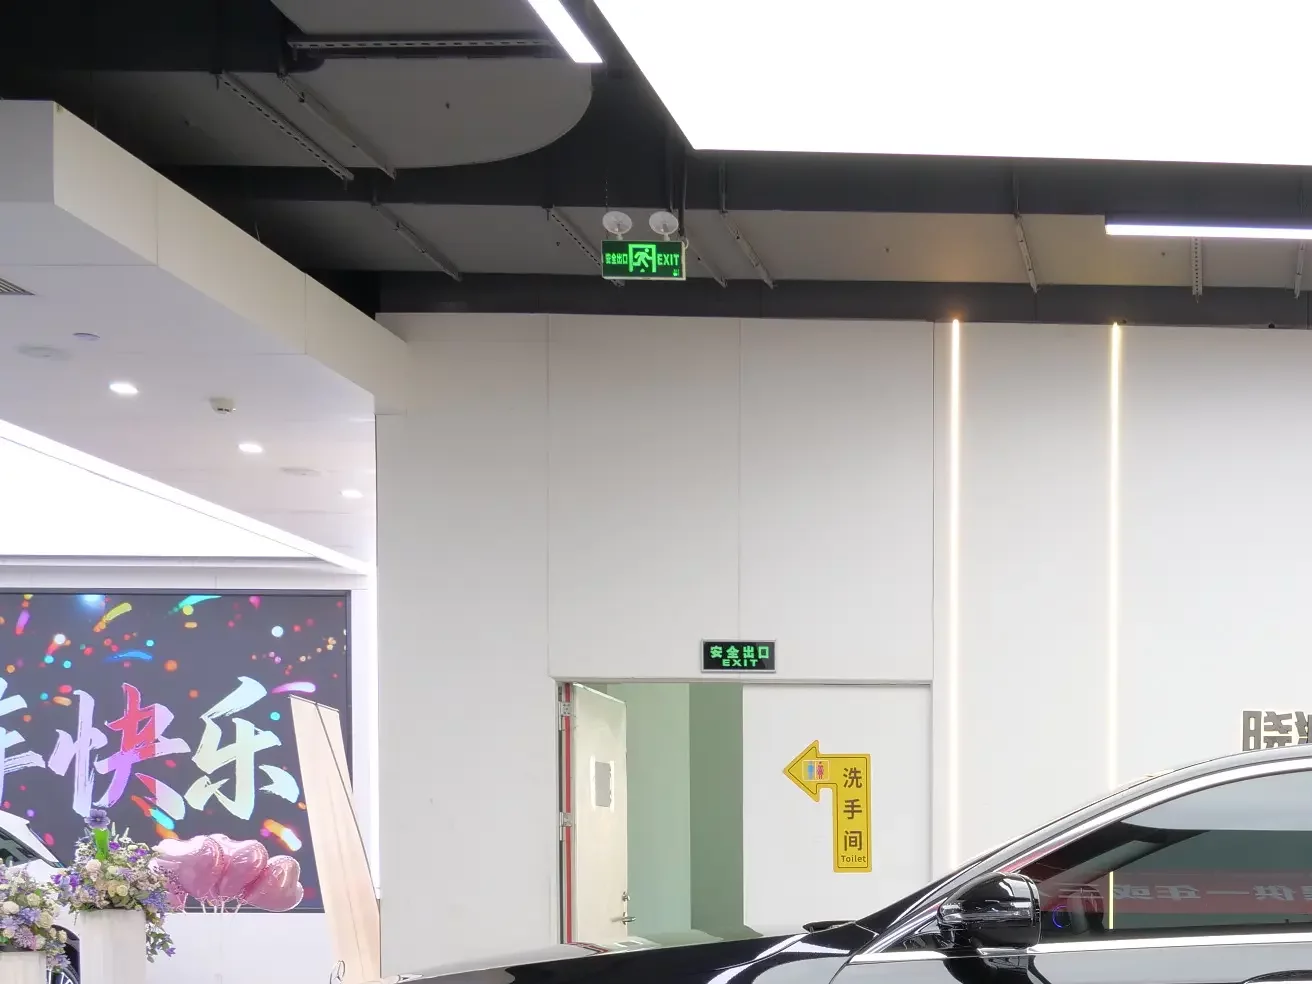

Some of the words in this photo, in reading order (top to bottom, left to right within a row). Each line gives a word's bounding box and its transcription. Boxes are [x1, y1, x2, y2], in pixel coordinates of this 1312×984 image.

[657, 253, 680, 266] EXIT
[709, 645, 770, 659] 安全出口
[722, 659, 759, 667] EXIT
[843, 767, 863, 851] 洗手间
[841, 855, 867, 863] Toilet
